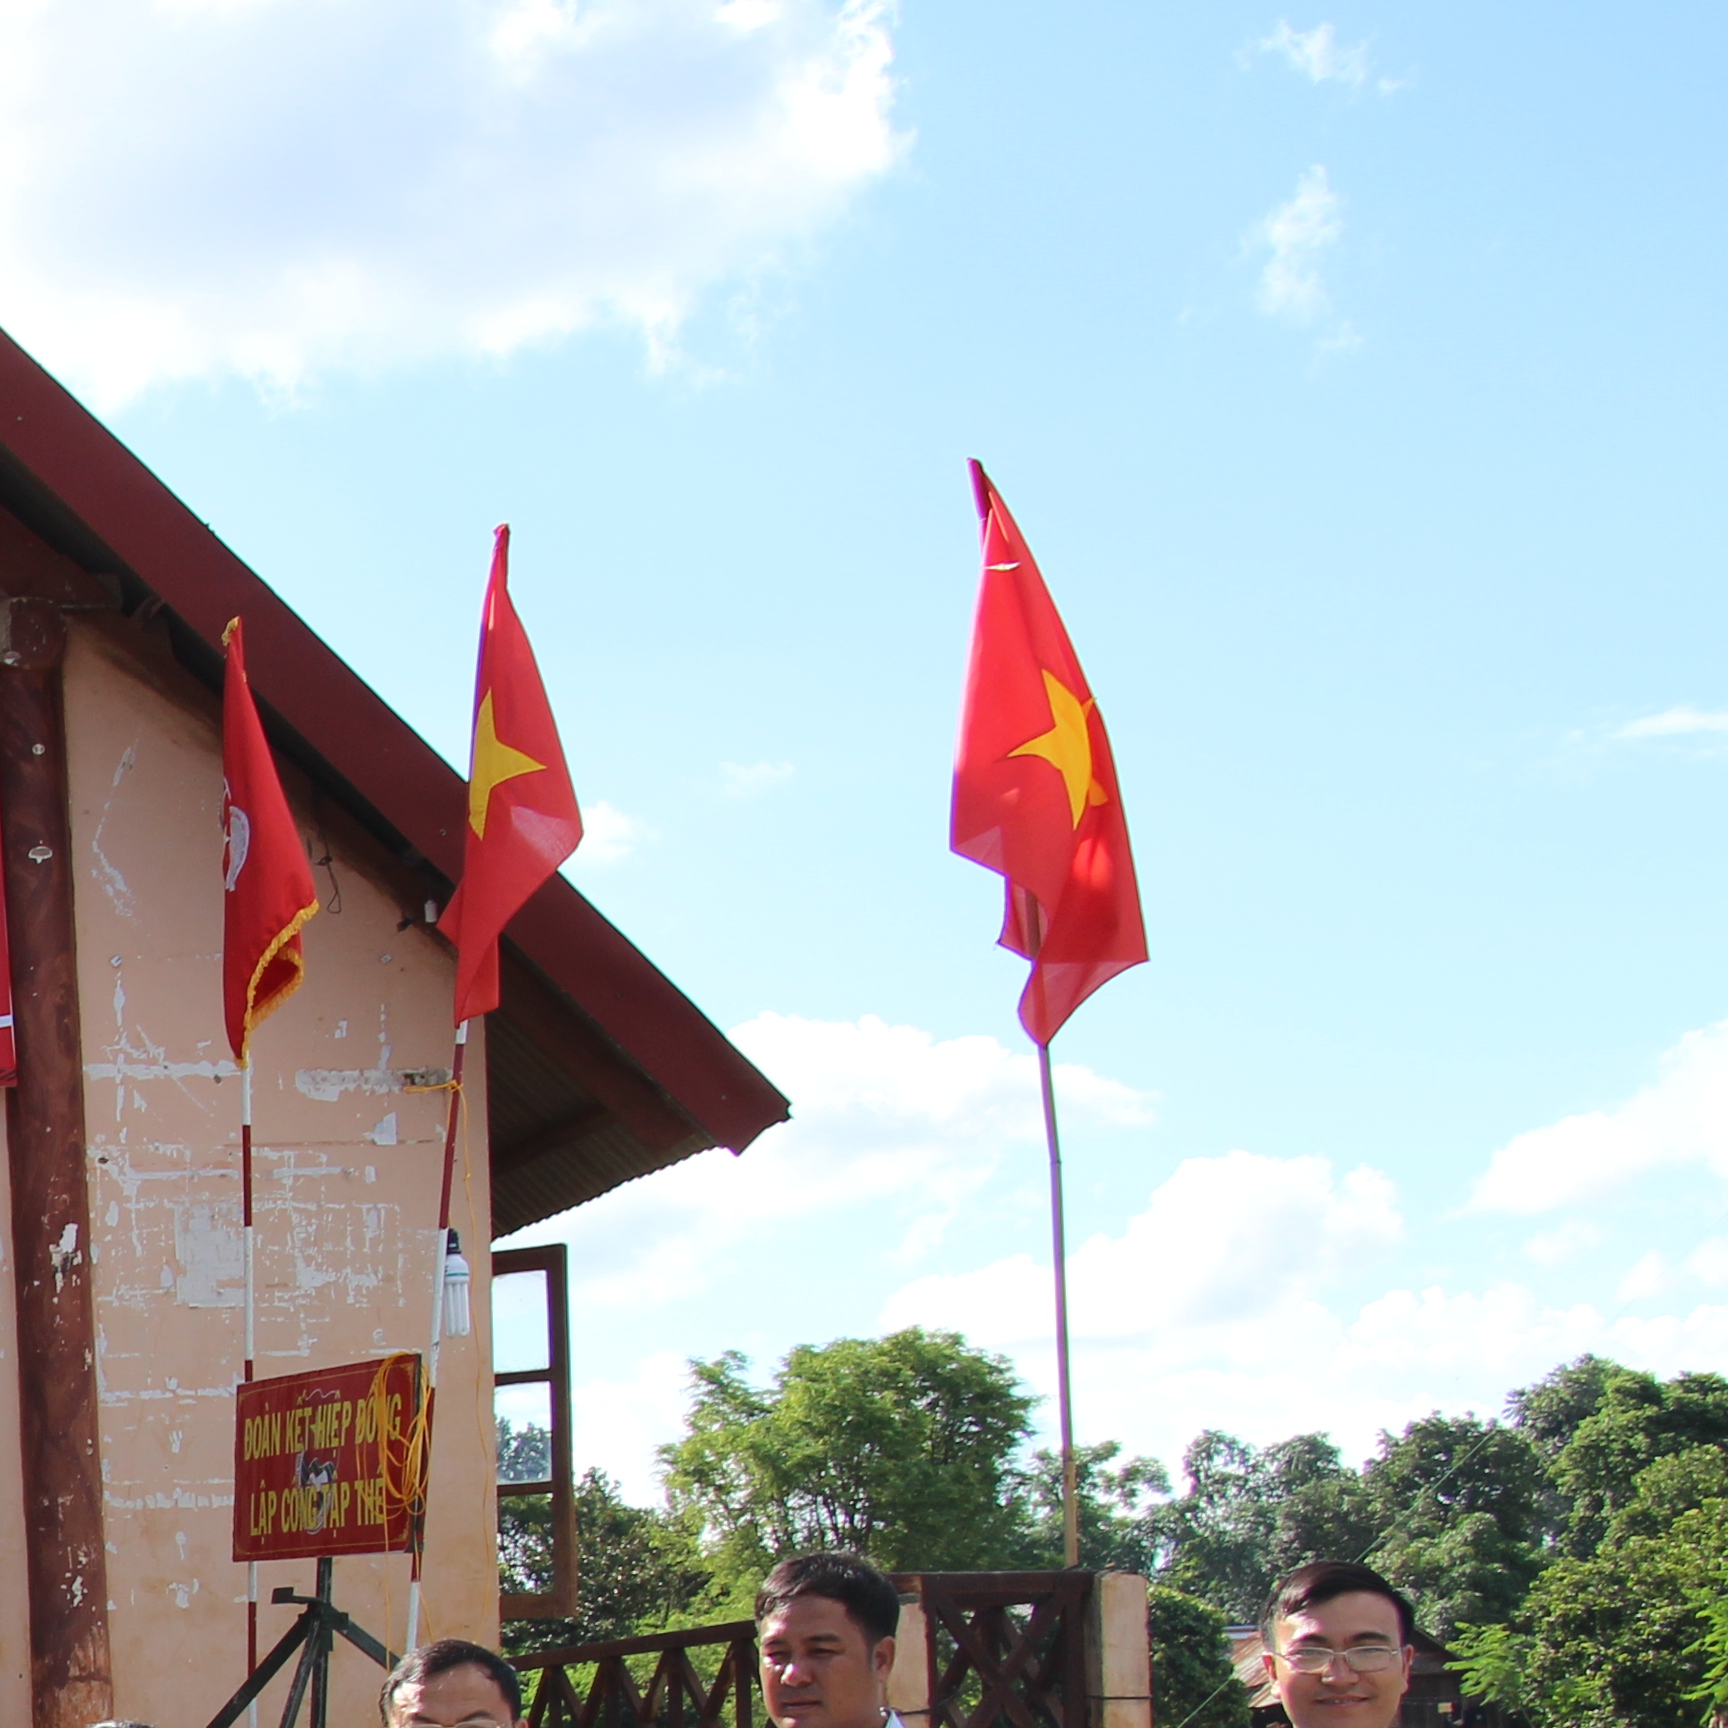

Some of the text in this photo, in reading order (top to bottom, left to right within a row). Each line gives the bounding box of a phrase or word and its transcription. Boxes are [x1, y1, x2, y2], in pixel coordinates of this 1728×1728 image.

[244, 1402, 281, 1460] ĐOÀN
[285, 1389, 312, 1453] KẾT
[315, 1389, 352, 1457] HIỆP
[250, 1479, 277, 1544] LẬP
[281, 1475, 318, 1532] CÔNG
[321, 1469, 351, 1537] TẬP
